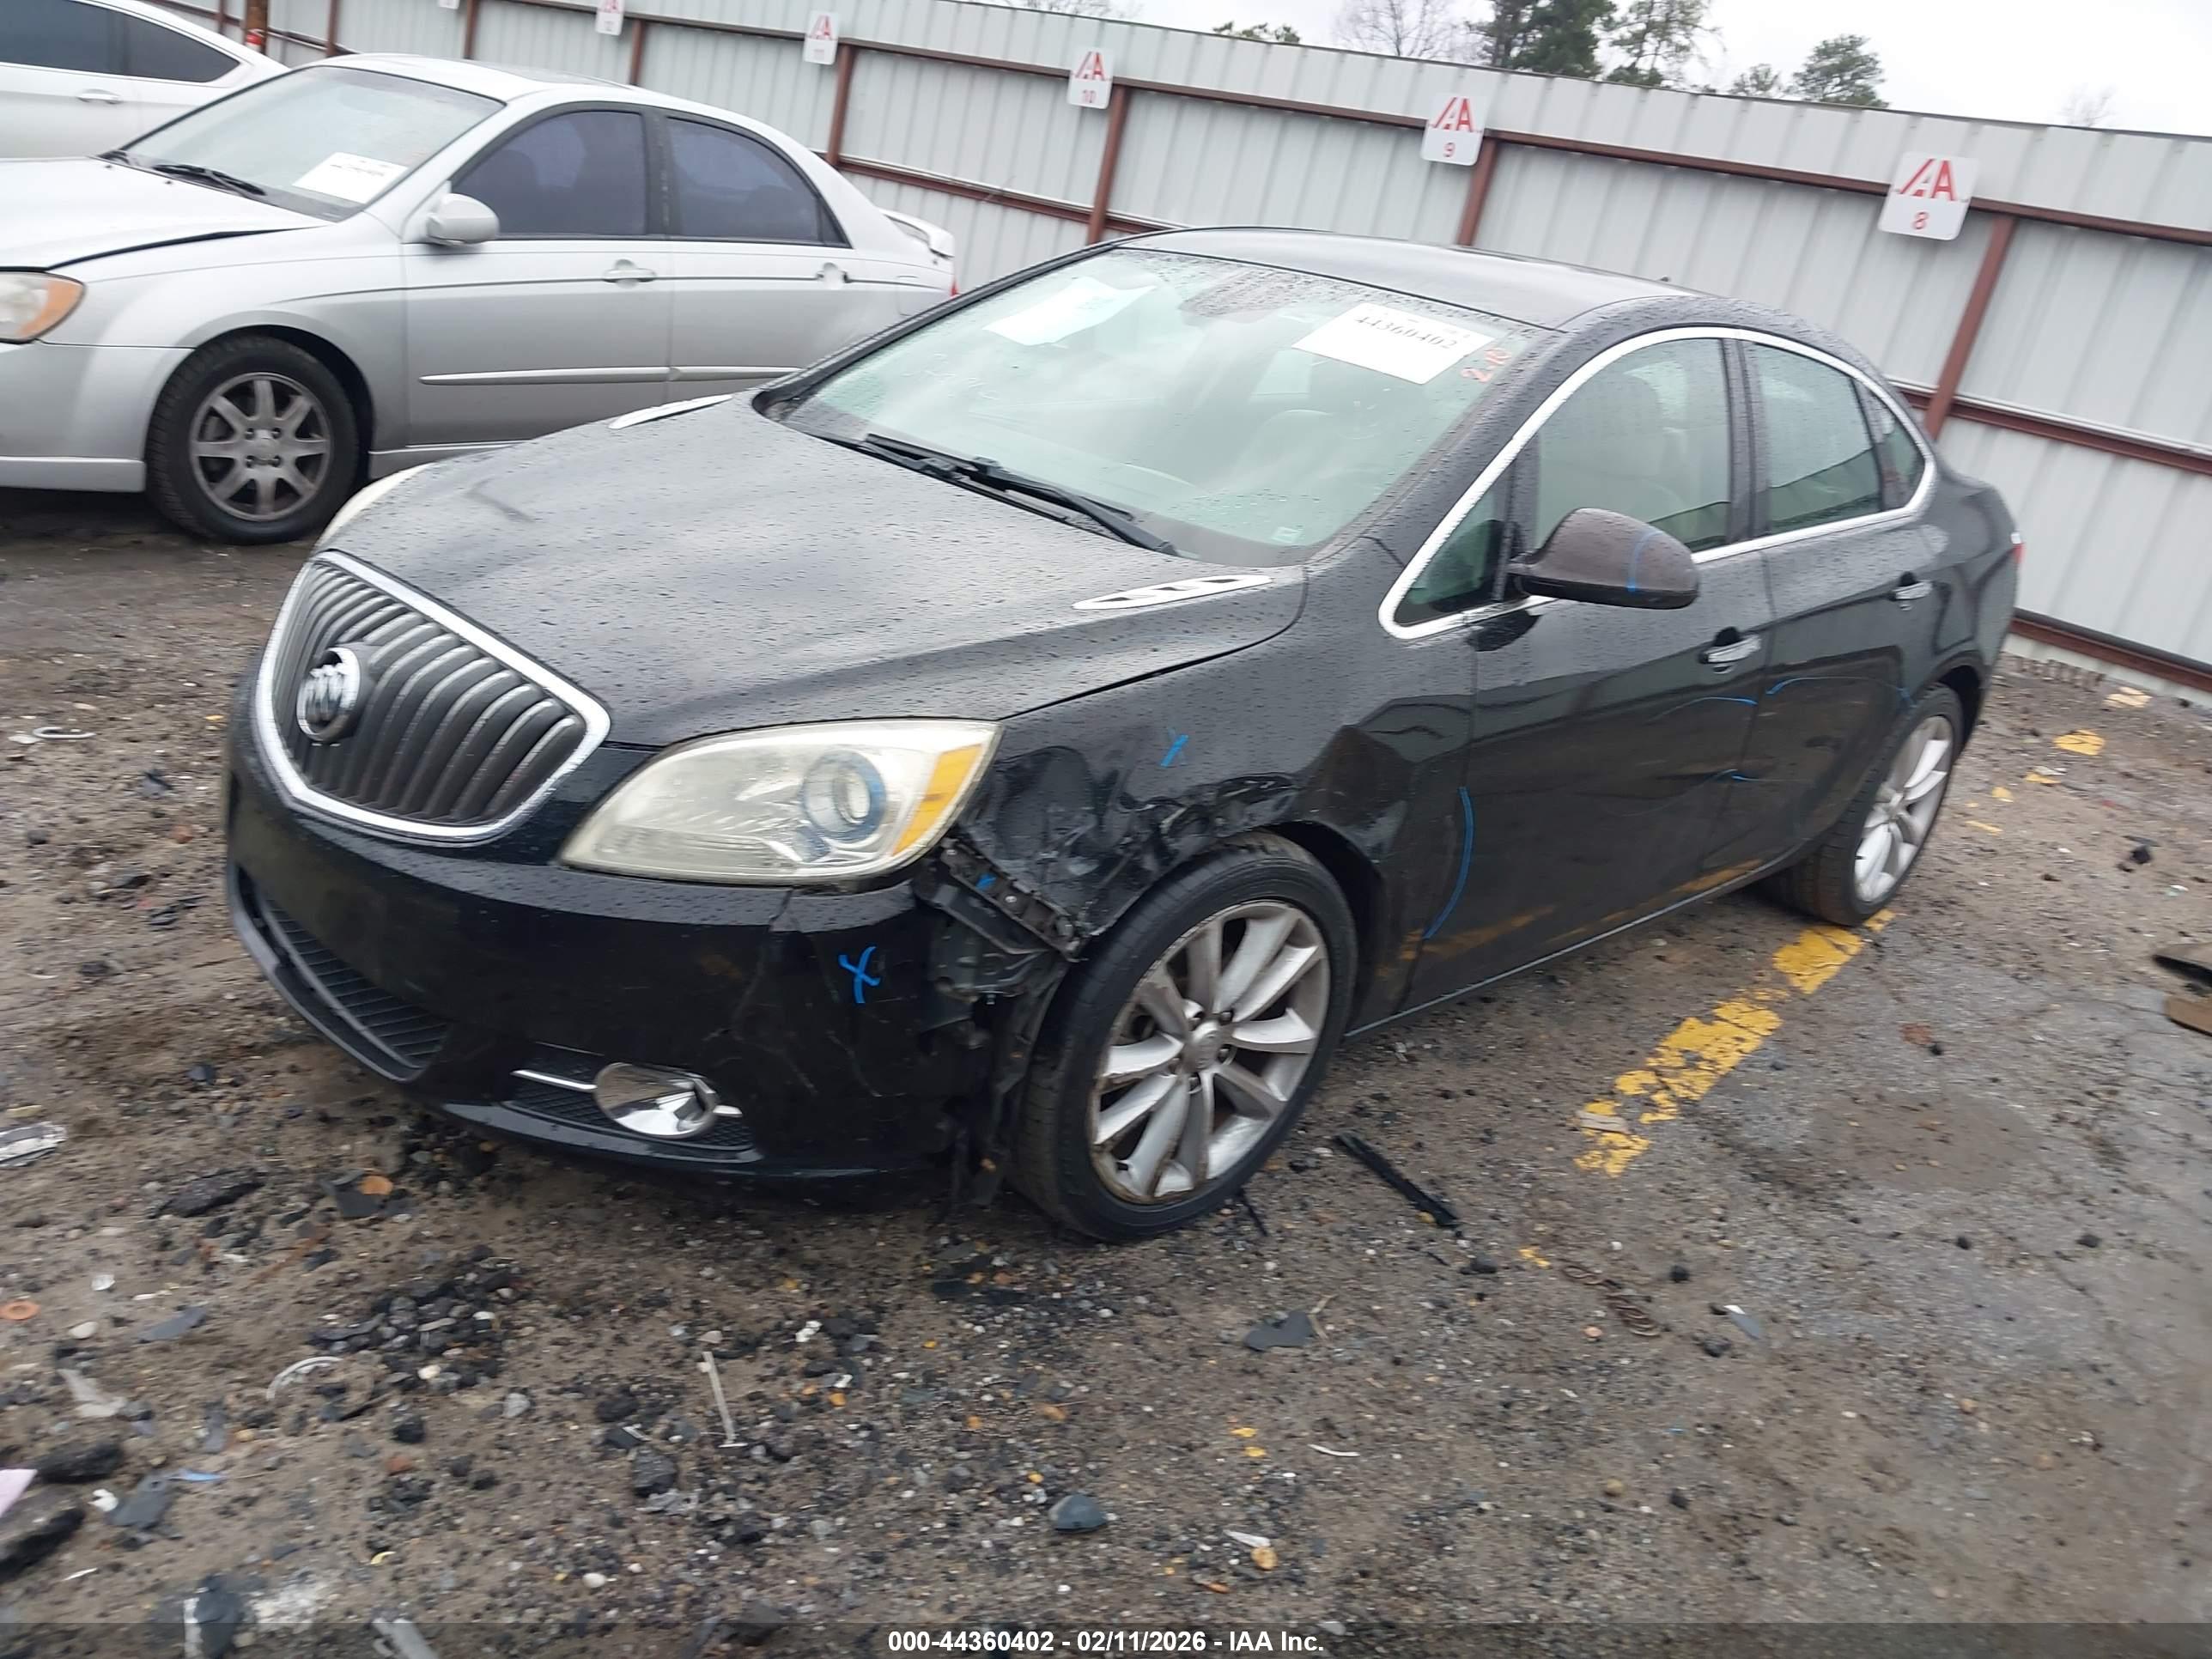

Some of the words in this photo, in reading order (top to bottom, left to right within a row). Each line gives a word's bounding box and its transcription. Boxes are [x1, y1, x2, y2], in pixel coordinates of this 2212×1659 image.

[1443, 142, 1456, 158] 9
[1912, 210, 1929, 231] 8
[1354, 315, 1458, 349] 44360402
